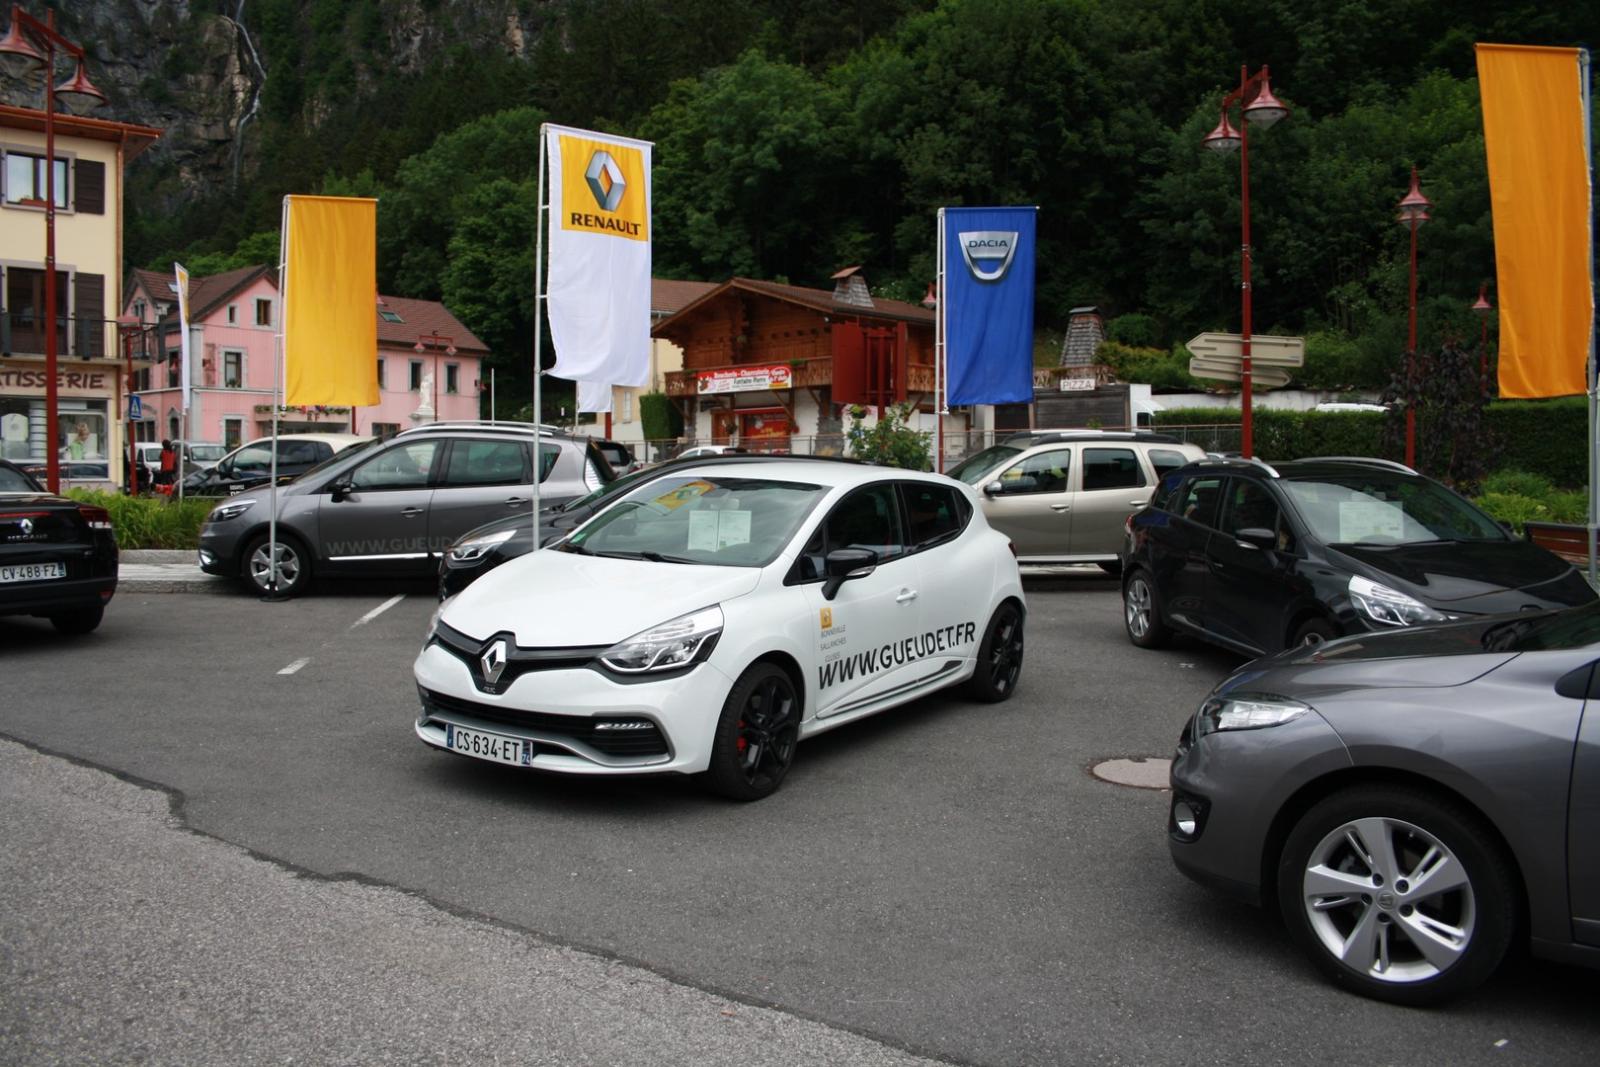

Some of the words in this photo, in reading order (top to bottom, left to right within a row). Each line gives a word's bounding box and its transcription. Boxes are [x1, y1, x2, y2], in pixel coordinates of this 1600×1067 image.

[571, 212, 641, 236] RENAULT
[968, 239, 1008, 248] DACIA
[0, 370, 104, 389] TISSERIE
[1062, 380, 1093, 390] PIZZA
[326, 536, 456, 554] WWW.GUEUD
[2, 564, 57, 580] CV-488-FZ
[818, 621, 976, 690] WWW.GUEUDET.FR
[456, 730, 520, 762] CS-634-ET
